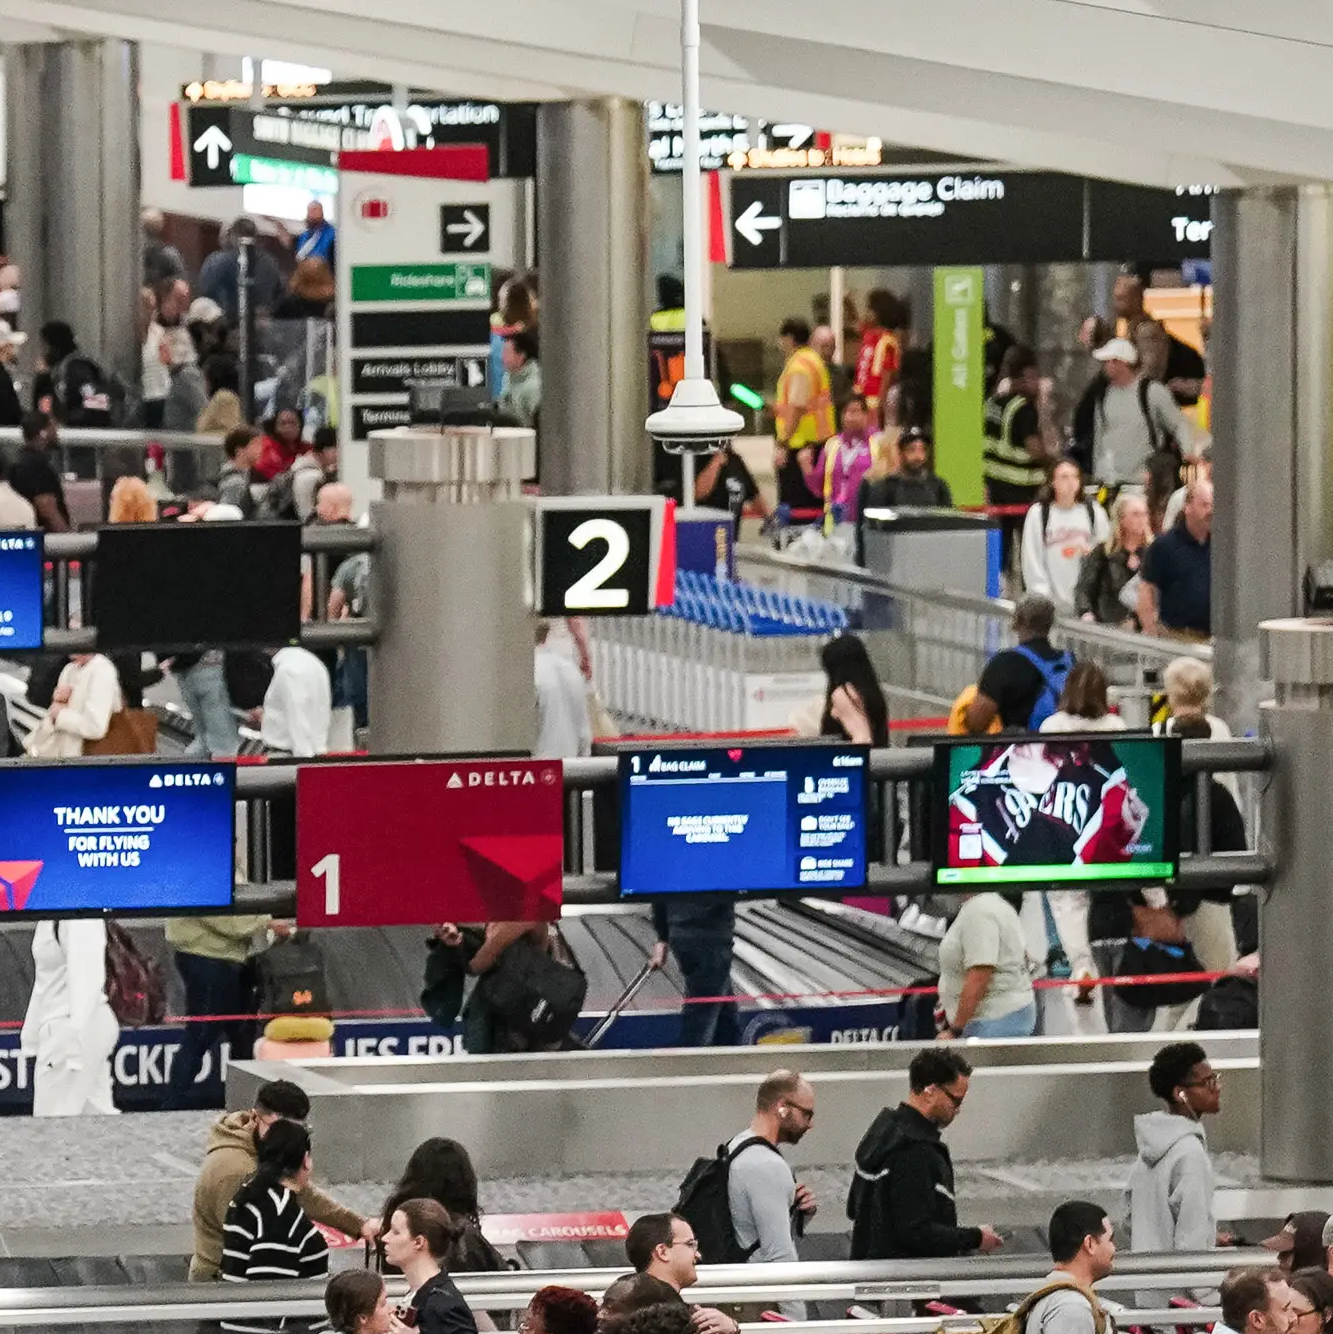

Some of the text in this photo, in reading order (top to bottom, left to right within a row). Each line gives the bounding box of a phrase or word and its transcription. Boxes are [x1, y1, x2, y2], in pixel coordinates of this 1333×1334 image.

[827, 175, 1006, 204] Baggage Claim
[564, 518, 631, 610] 2
[631, 755, 641, 774] 1
[164, 773, 212, 787] DELTA
[467, 770, 536, 787] DELTA
[53, 804, 166, 826] THANK YOU
[68, 834, 150, 852] FOR FLYING
[78, 851, 141, 868] WITH US
[310, 853, 342, 916] 1
[528, 1224, 627, 1239] CAROUSELS
